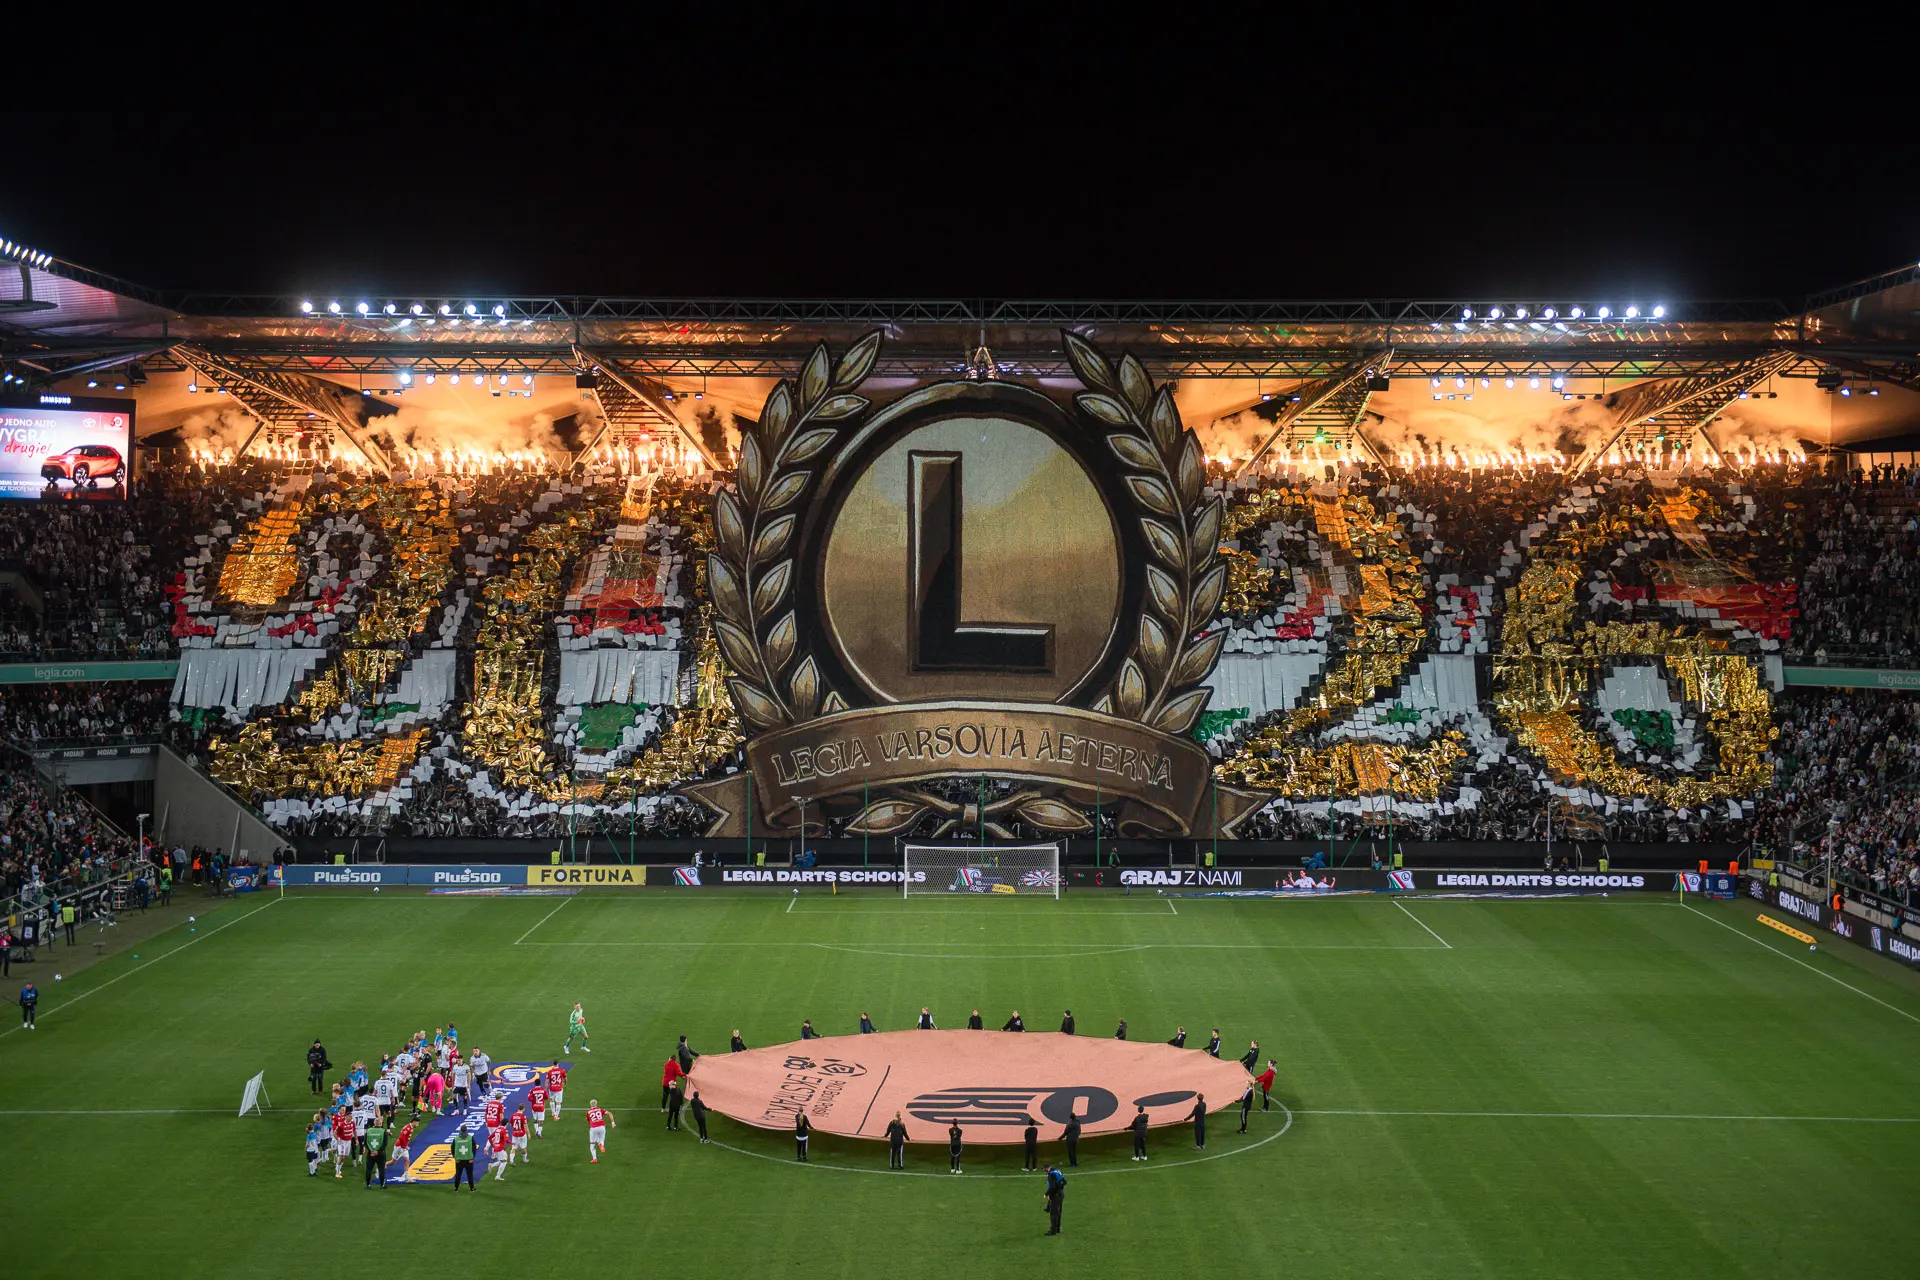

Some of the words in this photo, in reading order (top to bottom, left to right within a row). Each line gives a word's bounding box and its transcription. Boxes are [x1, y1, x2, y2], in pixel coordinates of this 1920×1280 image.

[4, 418, 33, 427] JEDNO
[35, 419, 57, 428] AUTO
[908, 450, 1055, 671] L
[34, 668, 85, 680] legia.com
[1878, 673, 1920, 686] legia.co
[772, 738, 870, 786] LEGIA
[878, 724, 1026, 761] VARSOVIA
[1036, 730, 1174, 790] AETERNA
[314, 868, 381, 883] Plus500
[434, 868, 501, 883] Plus500
[541, 869, 634, 883] FORTUNA
[723, 870, 774, 882] LEGIA
[777, 870, 836, 882] DARTS
[839, 870, 926, 883] SCHOOLS
[1120, 870, 1182, 885] GRAJ
[1184, 871, 1196, 885] Z
[1198, 871, 1242, 886] NAMI
[1437, 874, 1489, 886] LEGIA
[1491, 874, 1554, 886] DARTS
[1555, 874, 1645, 887] SCHOOLS
[1779, 891, 1800, 912] GRAJ
[1889, 938, 1911, 959] LEGIA
[551, 1074, 562, 1085] 34
[380, 1085, 387, 1095] 9
[363, 1100, 375, 1110] 22
[534, 1093, 544, 1104] 12
[487, 1107, 498, 1118] 52
[355, 1116, 364, 1126] 17
[513, 1119, 522, 1130] 41
